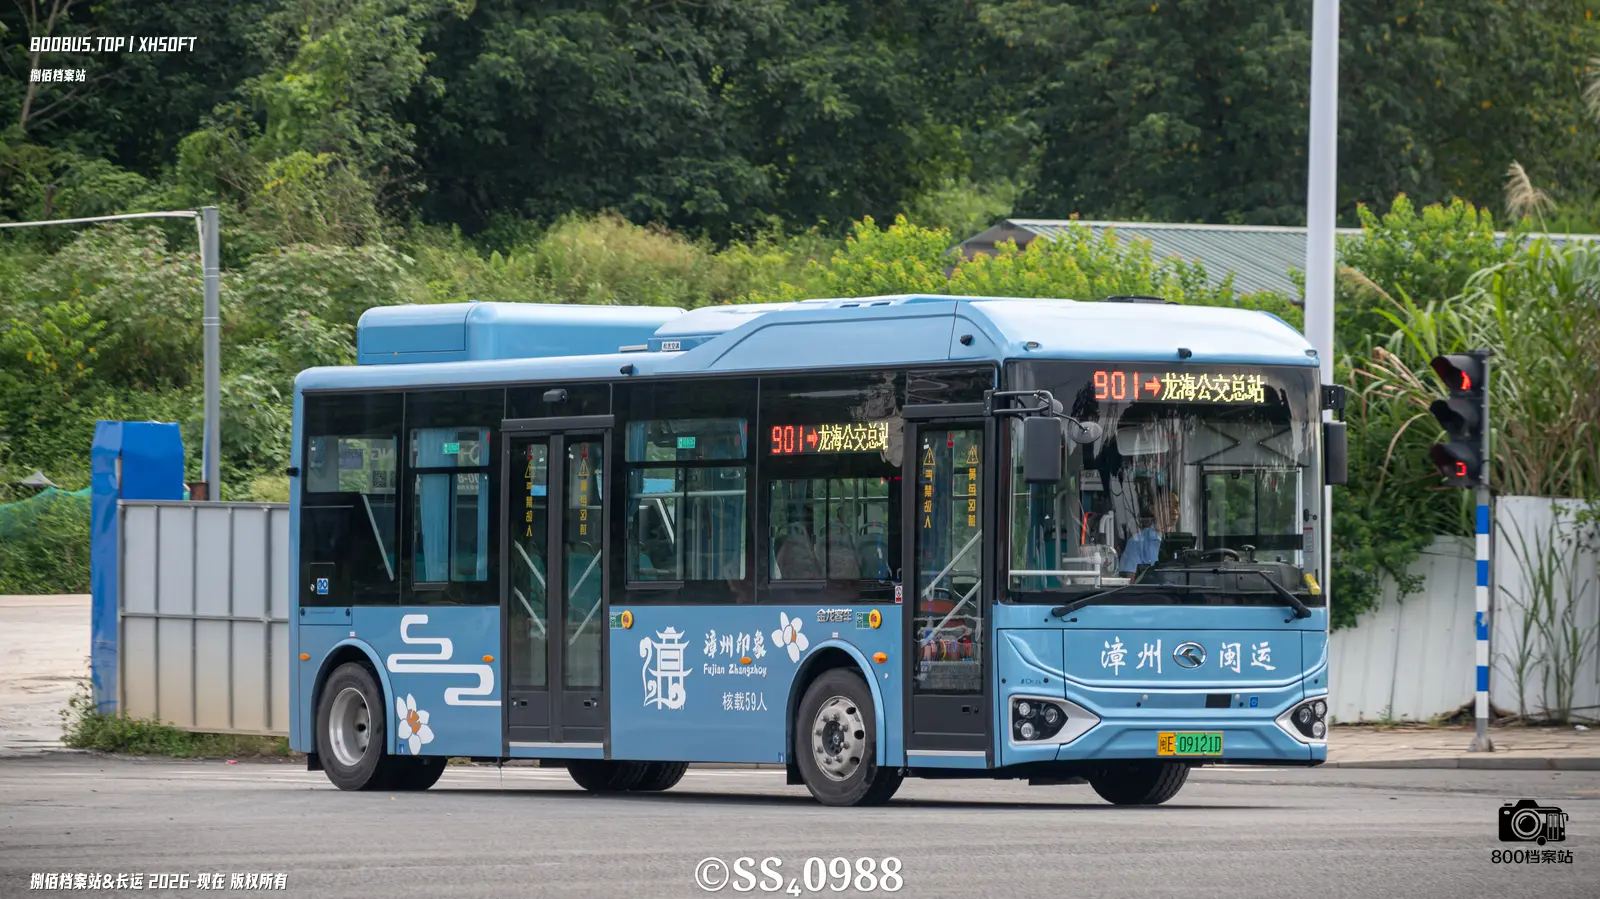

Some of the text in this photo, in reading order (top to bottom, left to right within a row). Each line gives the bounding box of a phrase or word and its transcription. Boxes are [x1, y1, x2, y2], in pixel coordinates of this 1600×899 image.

[1093, 371, 1265, 403] 901 龙海公交总站
[772, 425, 804, 454] 901
[816, 608, 853, 623] 金龙客车
[703, 629, 767, 659] 漳州印象
[1101, 636, 1277, 676] 漳州 闽运
[703, 663, 725, 677] Fujian
[722, 691, 768, 711] 核载59人
